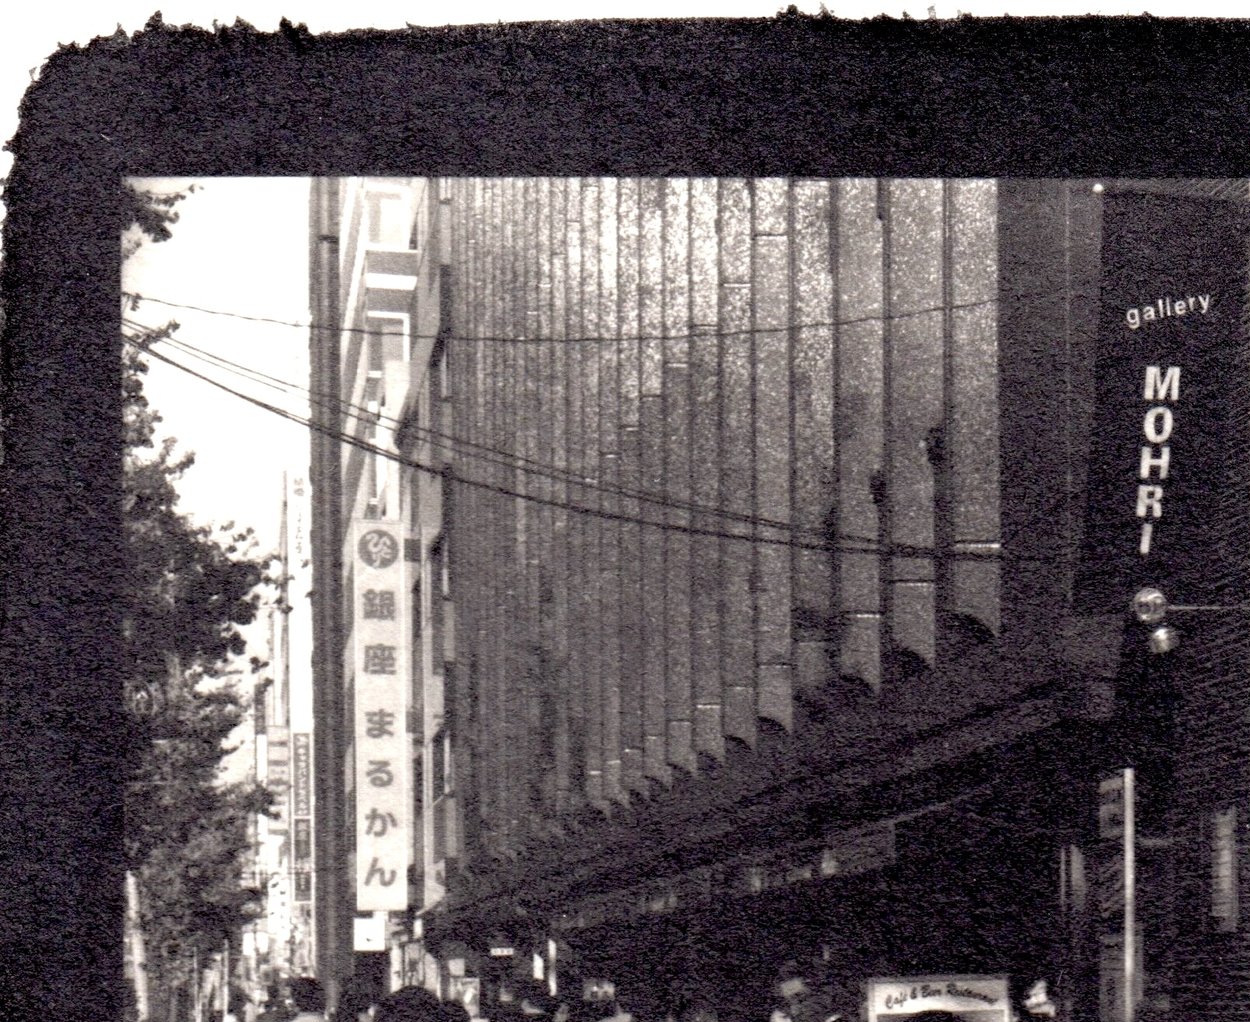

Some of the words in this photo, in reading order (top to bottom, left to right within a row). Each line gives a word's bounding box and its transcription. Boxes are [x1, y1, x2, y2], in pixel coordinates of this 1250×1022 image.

[1126, 293, 1210, 329] gallery
[1136, 365, 1181, 554] MOHRI
[363, 588, 398, 888] 銀座まるかん
